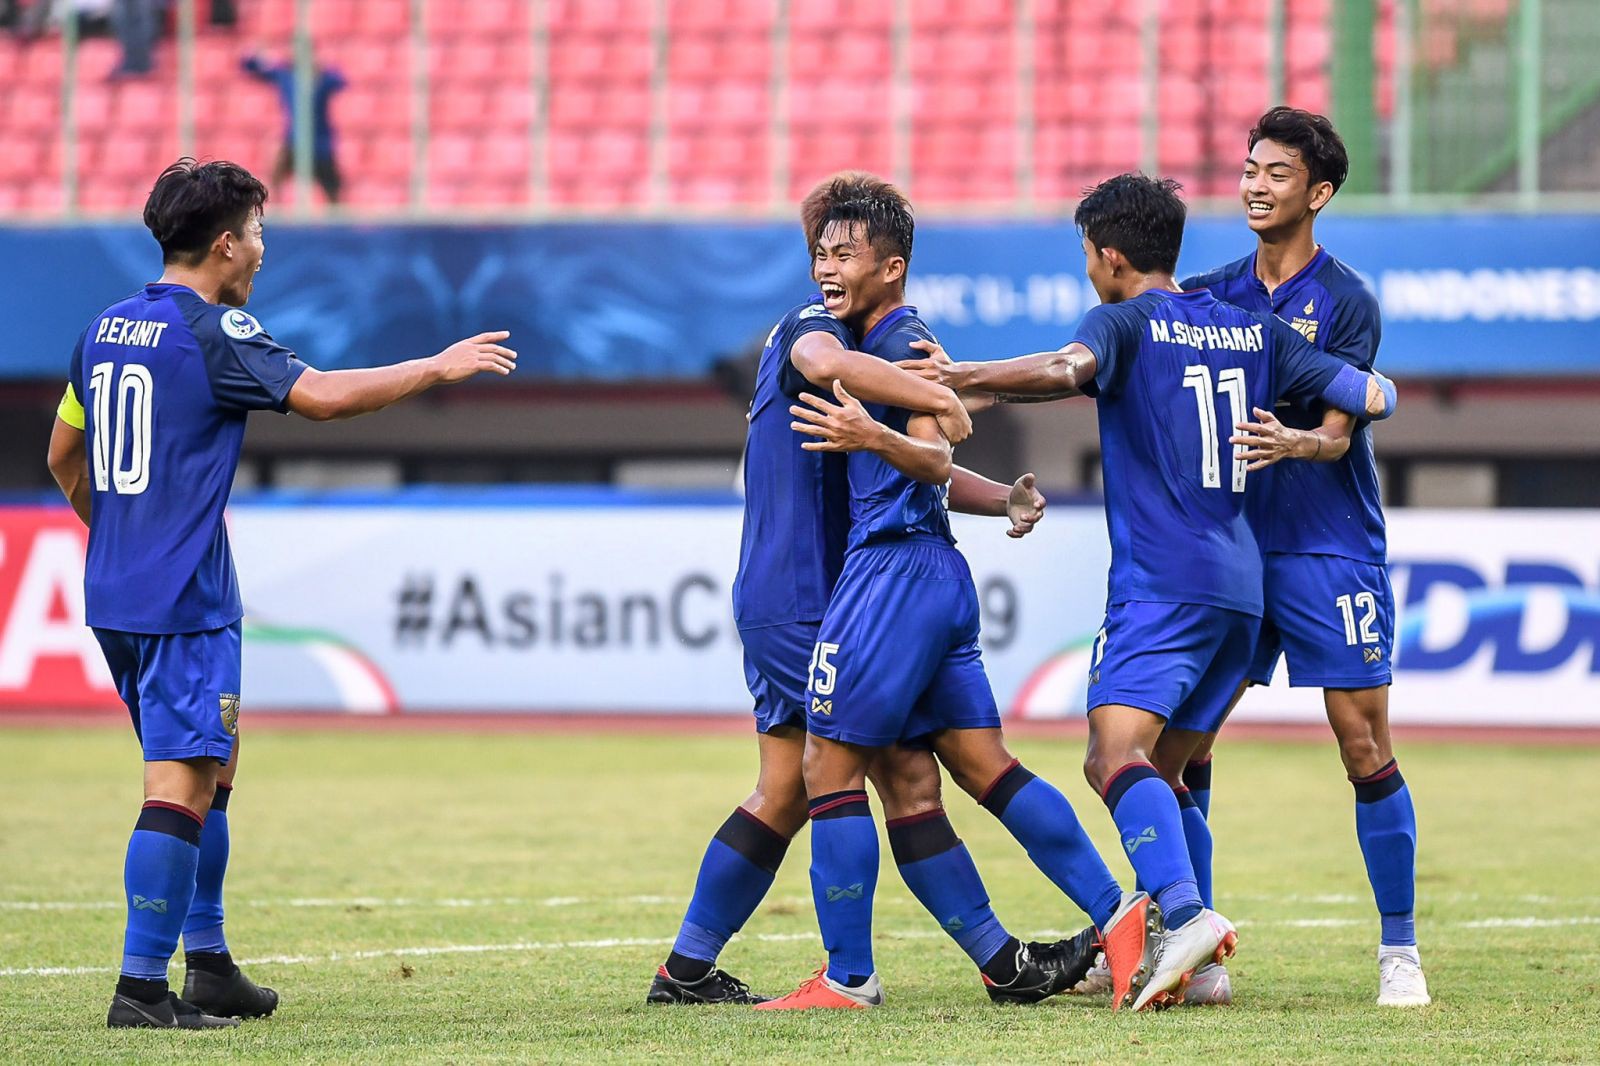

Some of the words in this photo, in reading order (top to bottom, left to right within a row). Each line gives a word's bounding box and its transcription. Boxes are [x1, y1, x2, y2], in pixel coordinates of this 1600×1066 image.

[94, 316, 169, 348] P.EKANIT
[1150, 319, 1263, 352] M.SUPHANAT
[89, 361, 153, 494] 10
[1182, 364, 1249, 493] 11
[1336, 591, 1379, 646] 12
